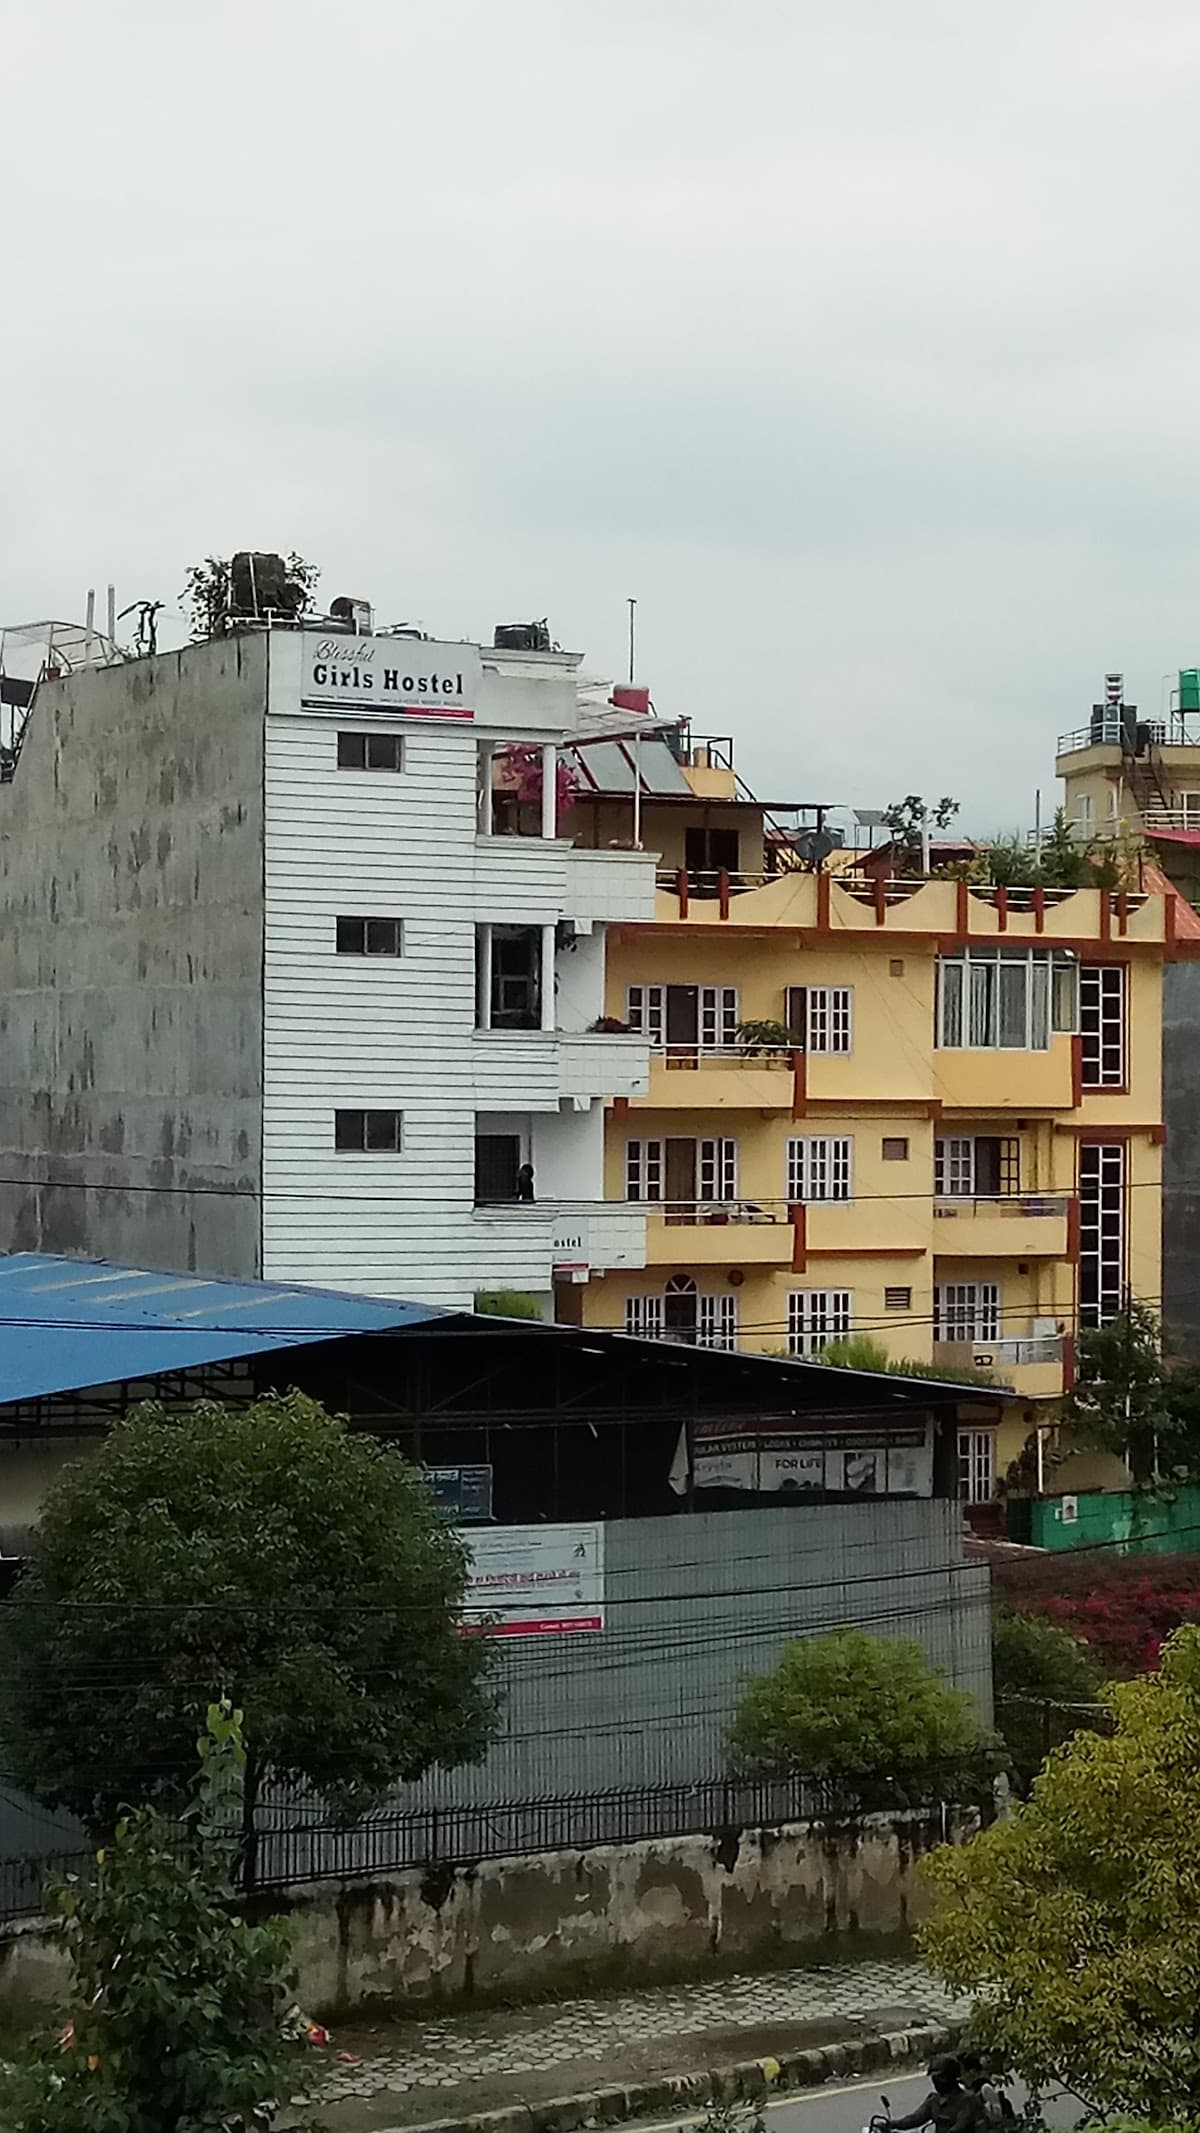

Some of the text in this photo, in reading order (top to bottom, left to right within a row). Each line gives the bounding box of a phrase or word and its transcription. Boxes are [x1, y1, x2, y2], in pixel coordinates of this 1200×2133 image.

[313, 639, 376, 666] Blissful
[313, 664, 463, 695] Girls Hostel
[553, 1235, 581, 1248] ostel
[775, 1458, 798, 1470] FOR
